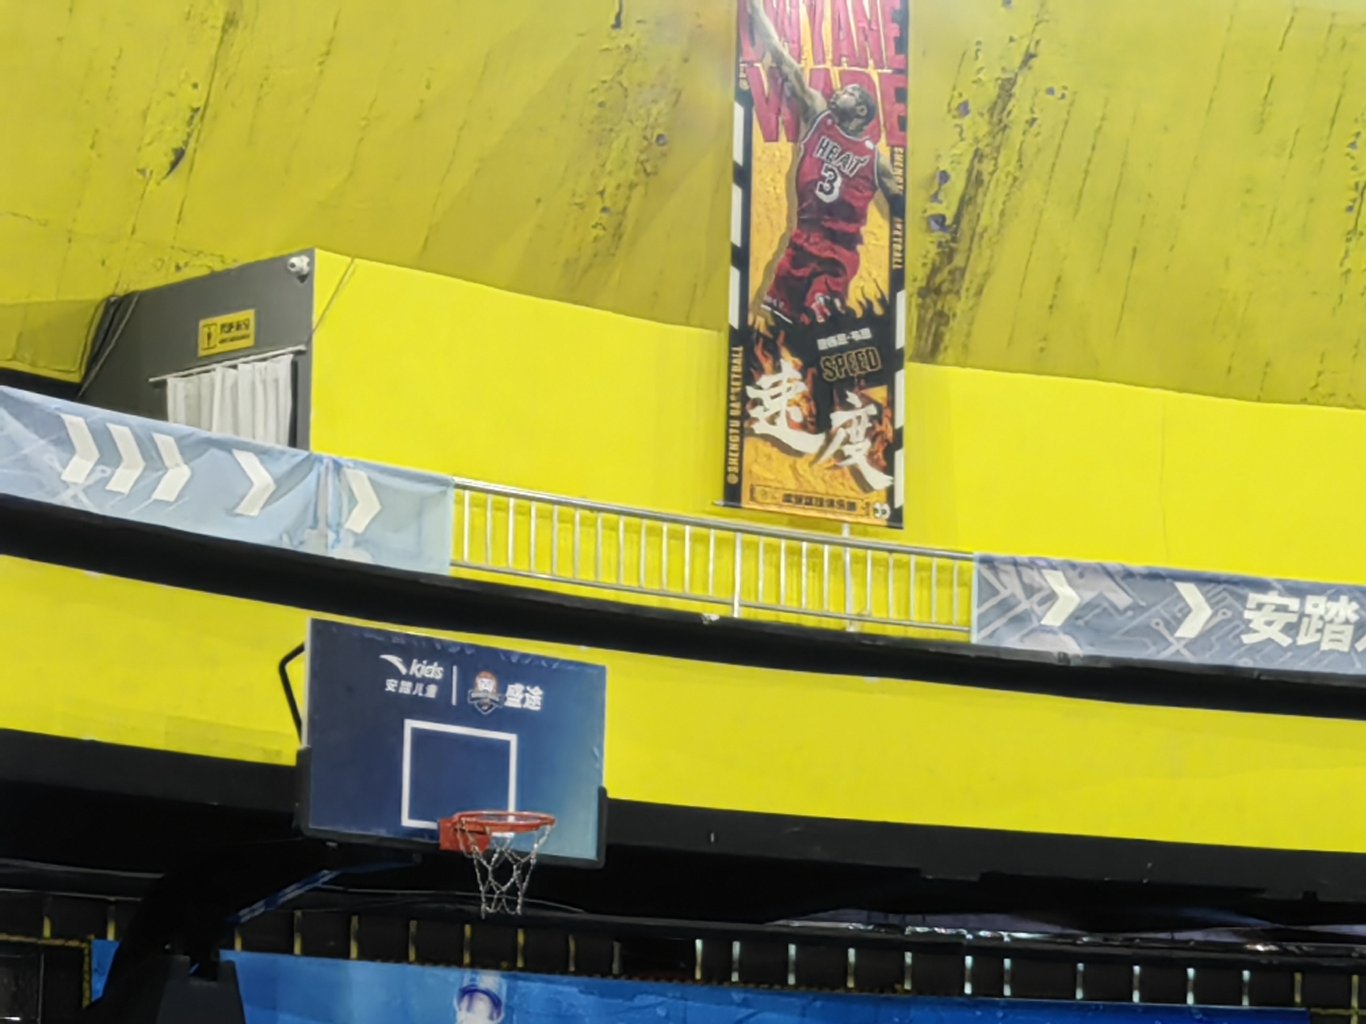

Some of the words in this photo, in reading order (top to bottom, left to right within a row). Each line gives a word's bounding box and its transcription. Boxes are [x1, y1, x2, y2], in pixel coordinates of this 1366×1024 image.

[815, 136, 868, 177] HEAT
[816, 164, 842, 203] 3
[821, 347, 882, 382] SPEED
[745, 357, 896, 492] 速度
[409, 659, 445, 680] kids
